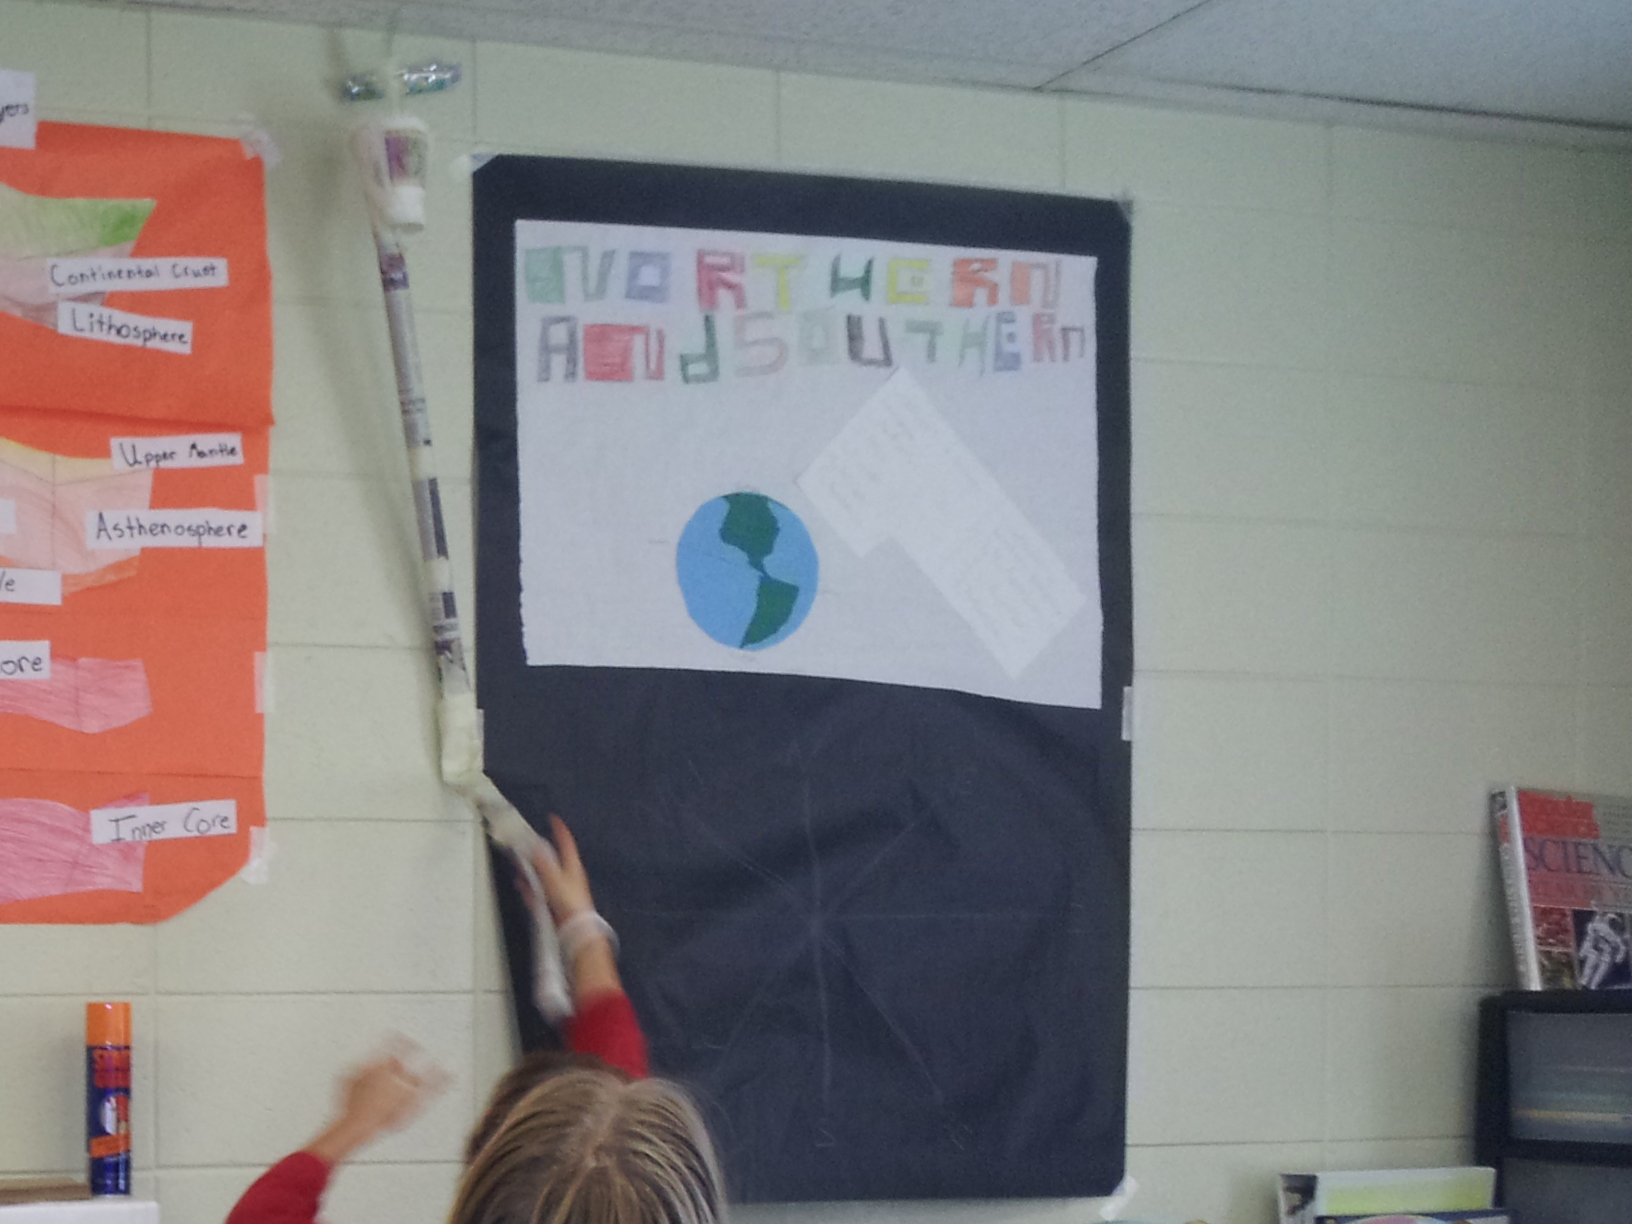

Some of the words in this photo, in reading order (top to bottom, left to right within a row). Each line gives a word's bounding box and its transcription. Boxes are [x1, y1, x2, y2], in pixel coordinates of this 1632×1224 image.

[49, 263, 161, 288] Continental
[171, 262, 218, 279] Crust
[71, 307, 189, 348] Lithosphere
[119, 441, 177, 469] Upper
[188, 441, 238, 459] Mantle
[95, 510, 250, 548] Asthenosphere
[108, 813, 168, 844] Inner
[183, 807, 232, 834] Core
